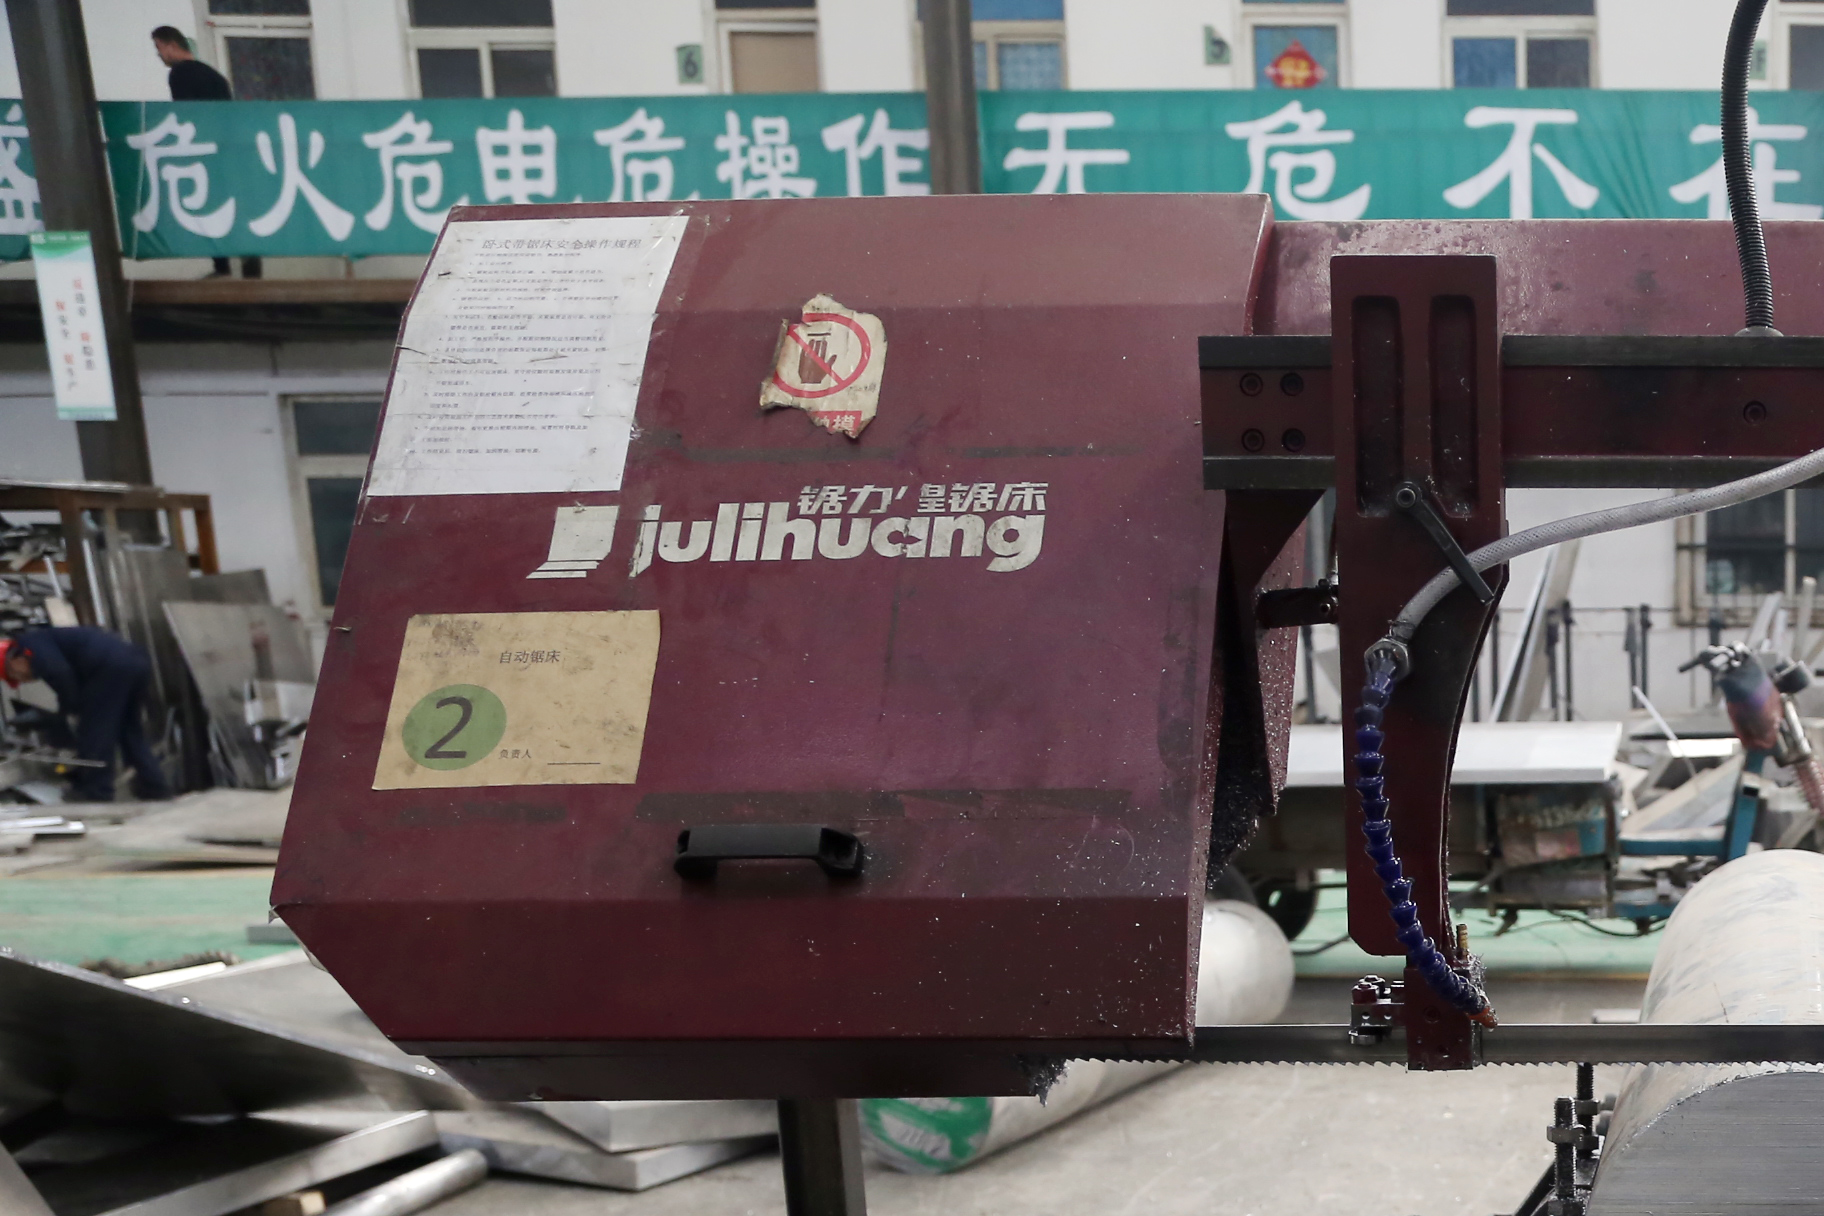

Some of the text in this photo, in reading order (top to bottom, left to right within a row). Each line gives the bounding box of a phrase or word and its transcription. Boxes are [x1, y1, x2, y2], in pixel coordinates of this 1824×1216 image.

[683, 49, 698, 79] 6
[628, 502, 1048, 572] julihuang
[499, 650, 561, 664] 自动锯床
[424, 695, 473, 759] 2
[499, 749, 532, 760] 负责人
